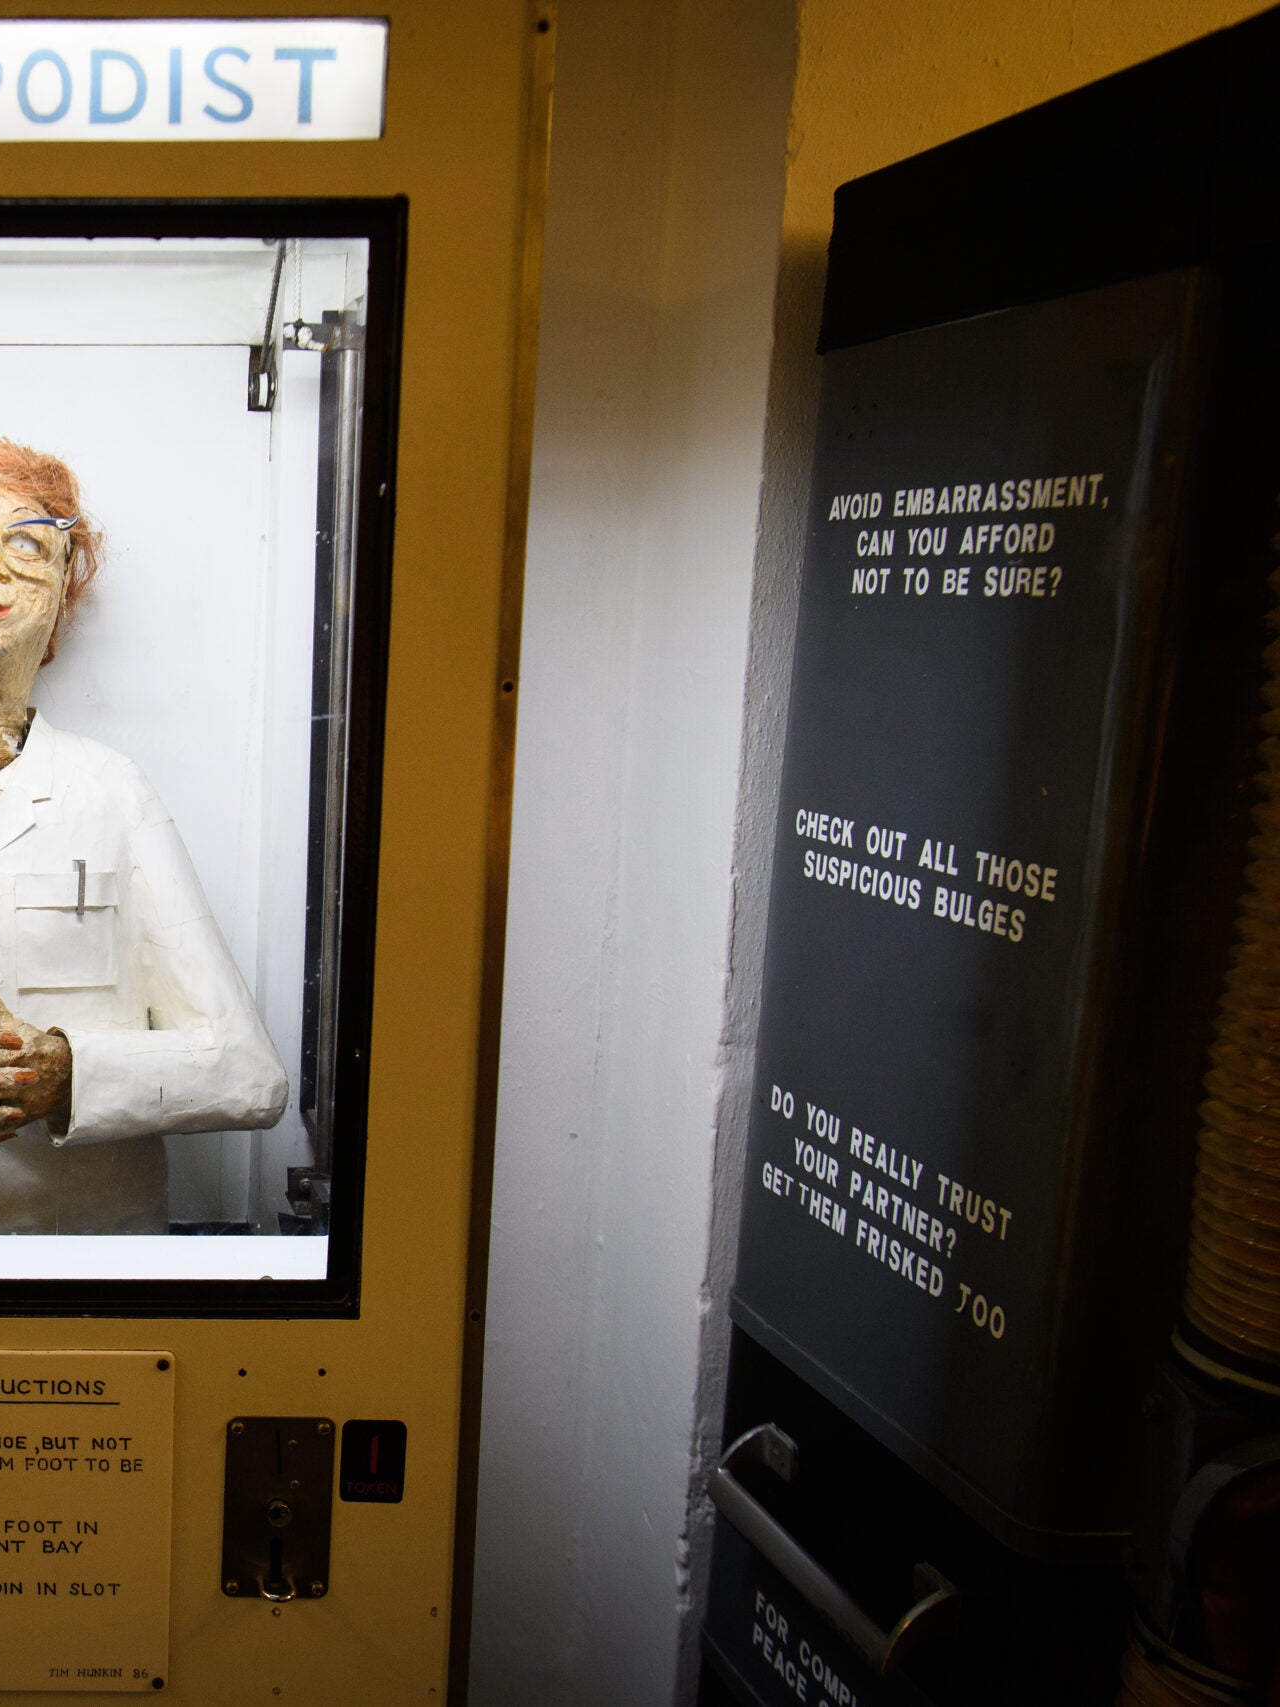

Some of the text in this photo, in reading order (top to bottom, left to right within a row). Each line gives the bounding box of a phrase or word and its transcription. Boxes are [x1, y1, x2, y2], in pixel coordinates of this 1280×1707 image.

[829, 473, 1109, 520] AVOID EMBARRASSMENT,
[857, 523, 1056, 557] CAN YOU AFFORD
[851, 566, 1063, 597] NOT TO BE SURE?
[796, 808, 1058, 902] CHECK OUT ALL THOSE
[803, 849, 1026, 942] SUSPICIOUS BULGES
[771, 1084, 1012, 1240] DO YOU REALLY TRUST
[794, 1136, 957, 1259] YOUR PARTNER?
[762, 1161, 794, 1197] GET
[798, 1181, 847, 1237] THEM
[856, 1217, 944, 1298] FRISKED
[92, 1437, 133, 1451] NOT
[25, 1457, 77, 1472] FOOT
[85, 1458, 110, 1472] TO
[120, 1458, 144, 1473] BE
[345, 1480, 399, 1495] TOKEN
[4, 1520, 62, 1534] FOOT
[76, 1521, 99, 1535] IN
[42, 1540, 83, 1554] BAY
[37, 1582, 58, 1596] IN
[70, 1583, 121, 1596] SLOT
[754, 1589, 790, 1645] FOR
[48, 1667, 150, 1680] TIM HUNKIN 86
[752, 1621, 808, 1703] PEACE
